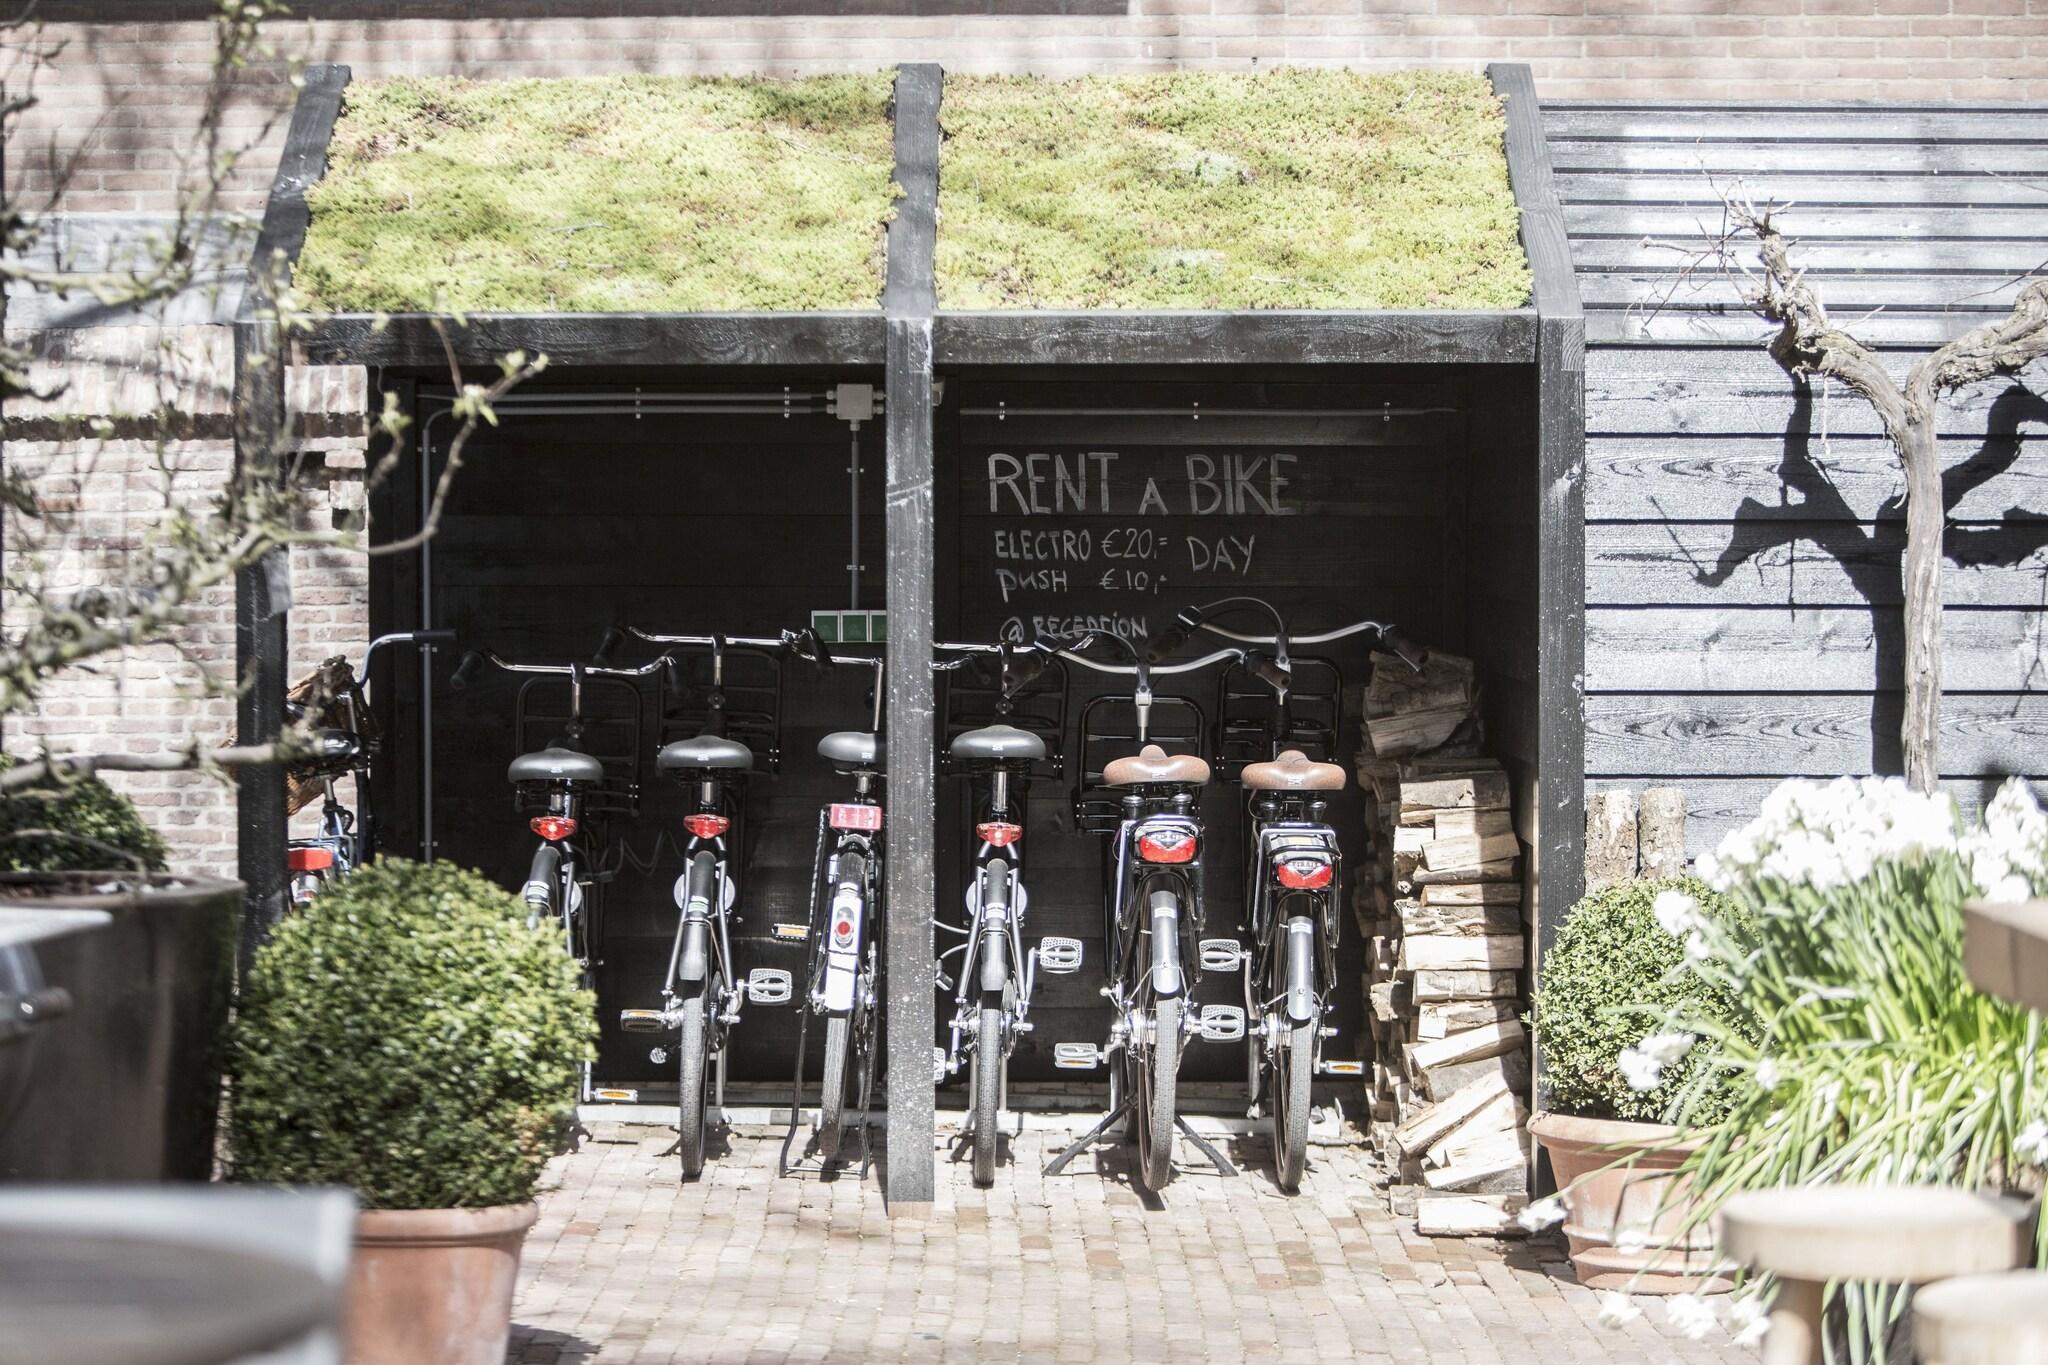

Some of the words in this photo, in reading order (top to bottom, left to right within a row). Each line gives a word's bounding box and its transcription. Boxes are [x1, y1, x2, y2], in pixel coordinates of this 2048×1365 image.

[987, 453, 1119, 515] RENT
[1138, 477, 1169, 515] A
[1186, 453, 1298, 516] BIKE
[995, 528, 1092, 561] ELECTRO
[1186, 534, 1255, 575] DAY
[1000, 616, 1025, 644] @
